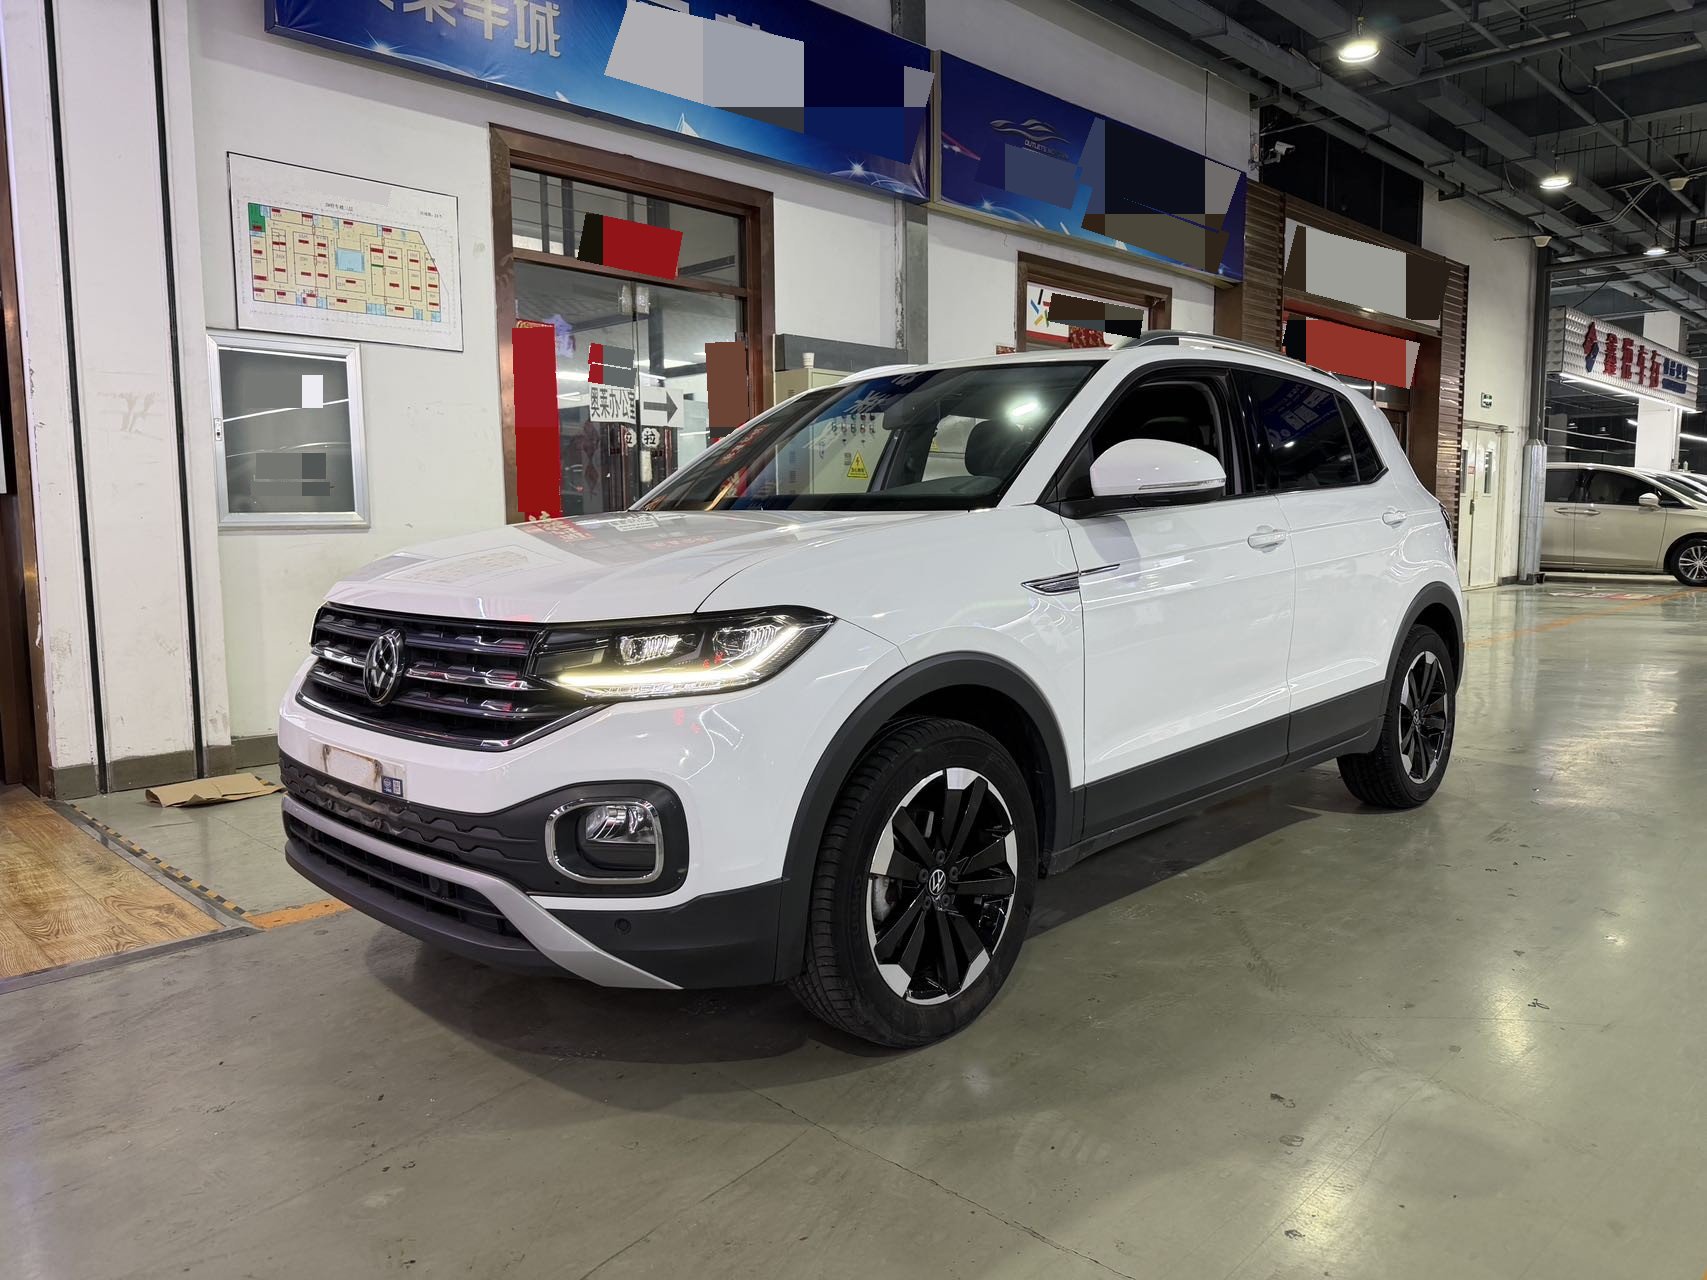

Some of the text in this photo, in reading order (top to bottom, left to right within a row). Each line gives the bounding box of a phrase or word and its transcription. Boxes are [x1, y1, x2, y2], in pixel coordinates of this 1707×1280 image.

[591, 387, 636, 420] 奥莱办公室
[644, 430, 657, 445] 拉
